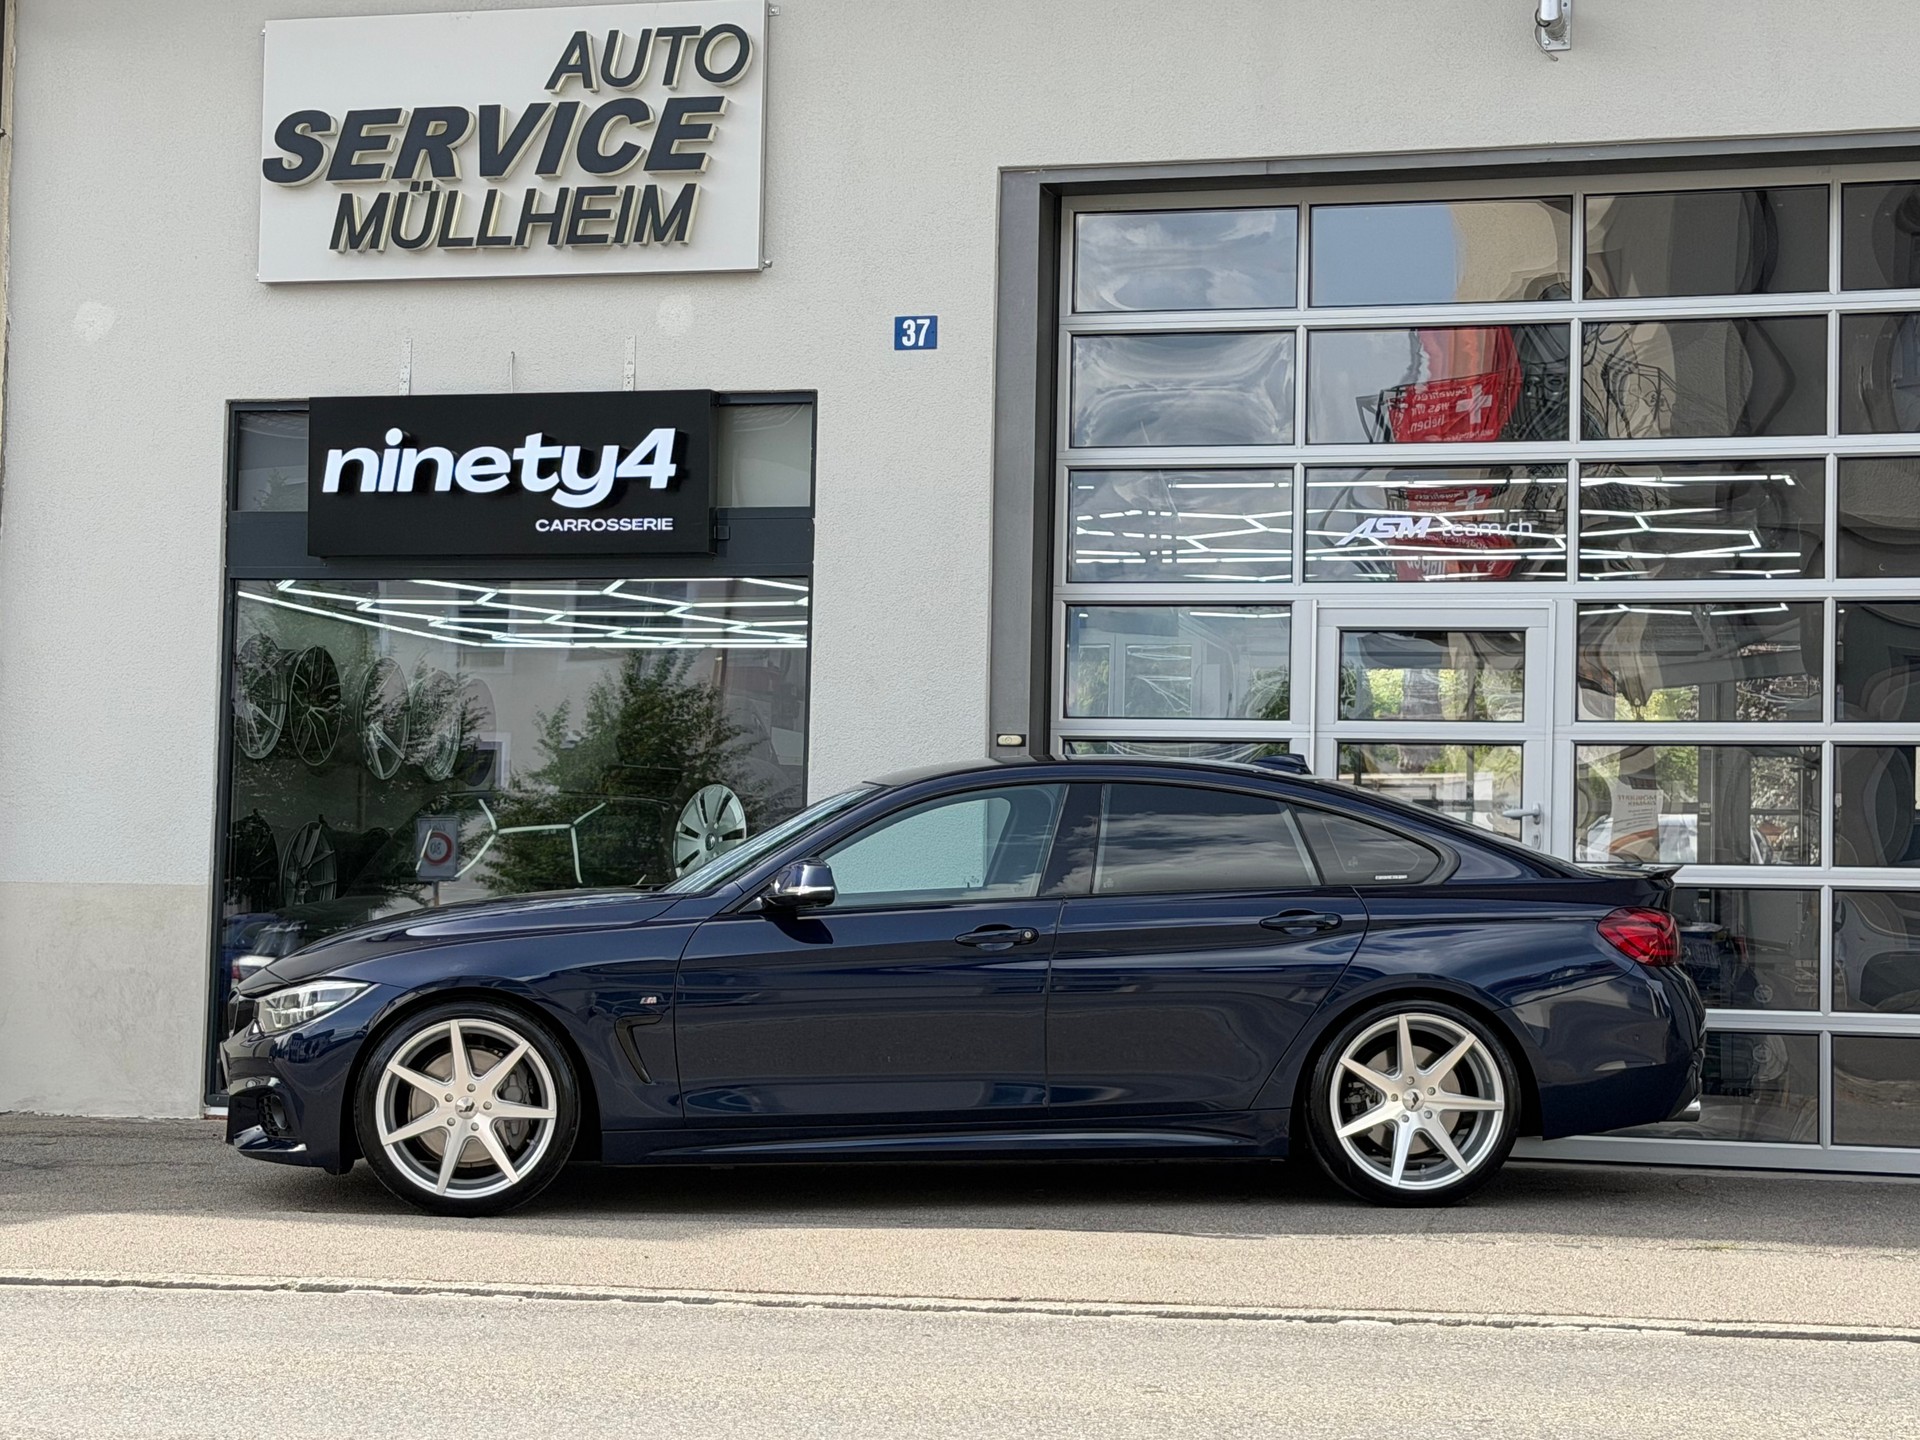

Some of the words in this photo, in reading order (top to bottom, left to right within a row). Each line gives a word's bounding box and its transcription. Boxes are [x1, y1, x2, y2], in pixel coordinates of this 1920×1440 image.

[544, 23, 753, 92] AUTO
[262, 96, 730, 186] SERVICE
[329, 180, 700, 253] MÜLLHEIM
[901, 318, 931, 347] 37
[322, 427, 677, 509] ninety4
[535, 517, 674, 532] CARROSSERIE
[1334, 516, 1432, 546] ASM
[1441, 518, 1533, 538] team.ch
